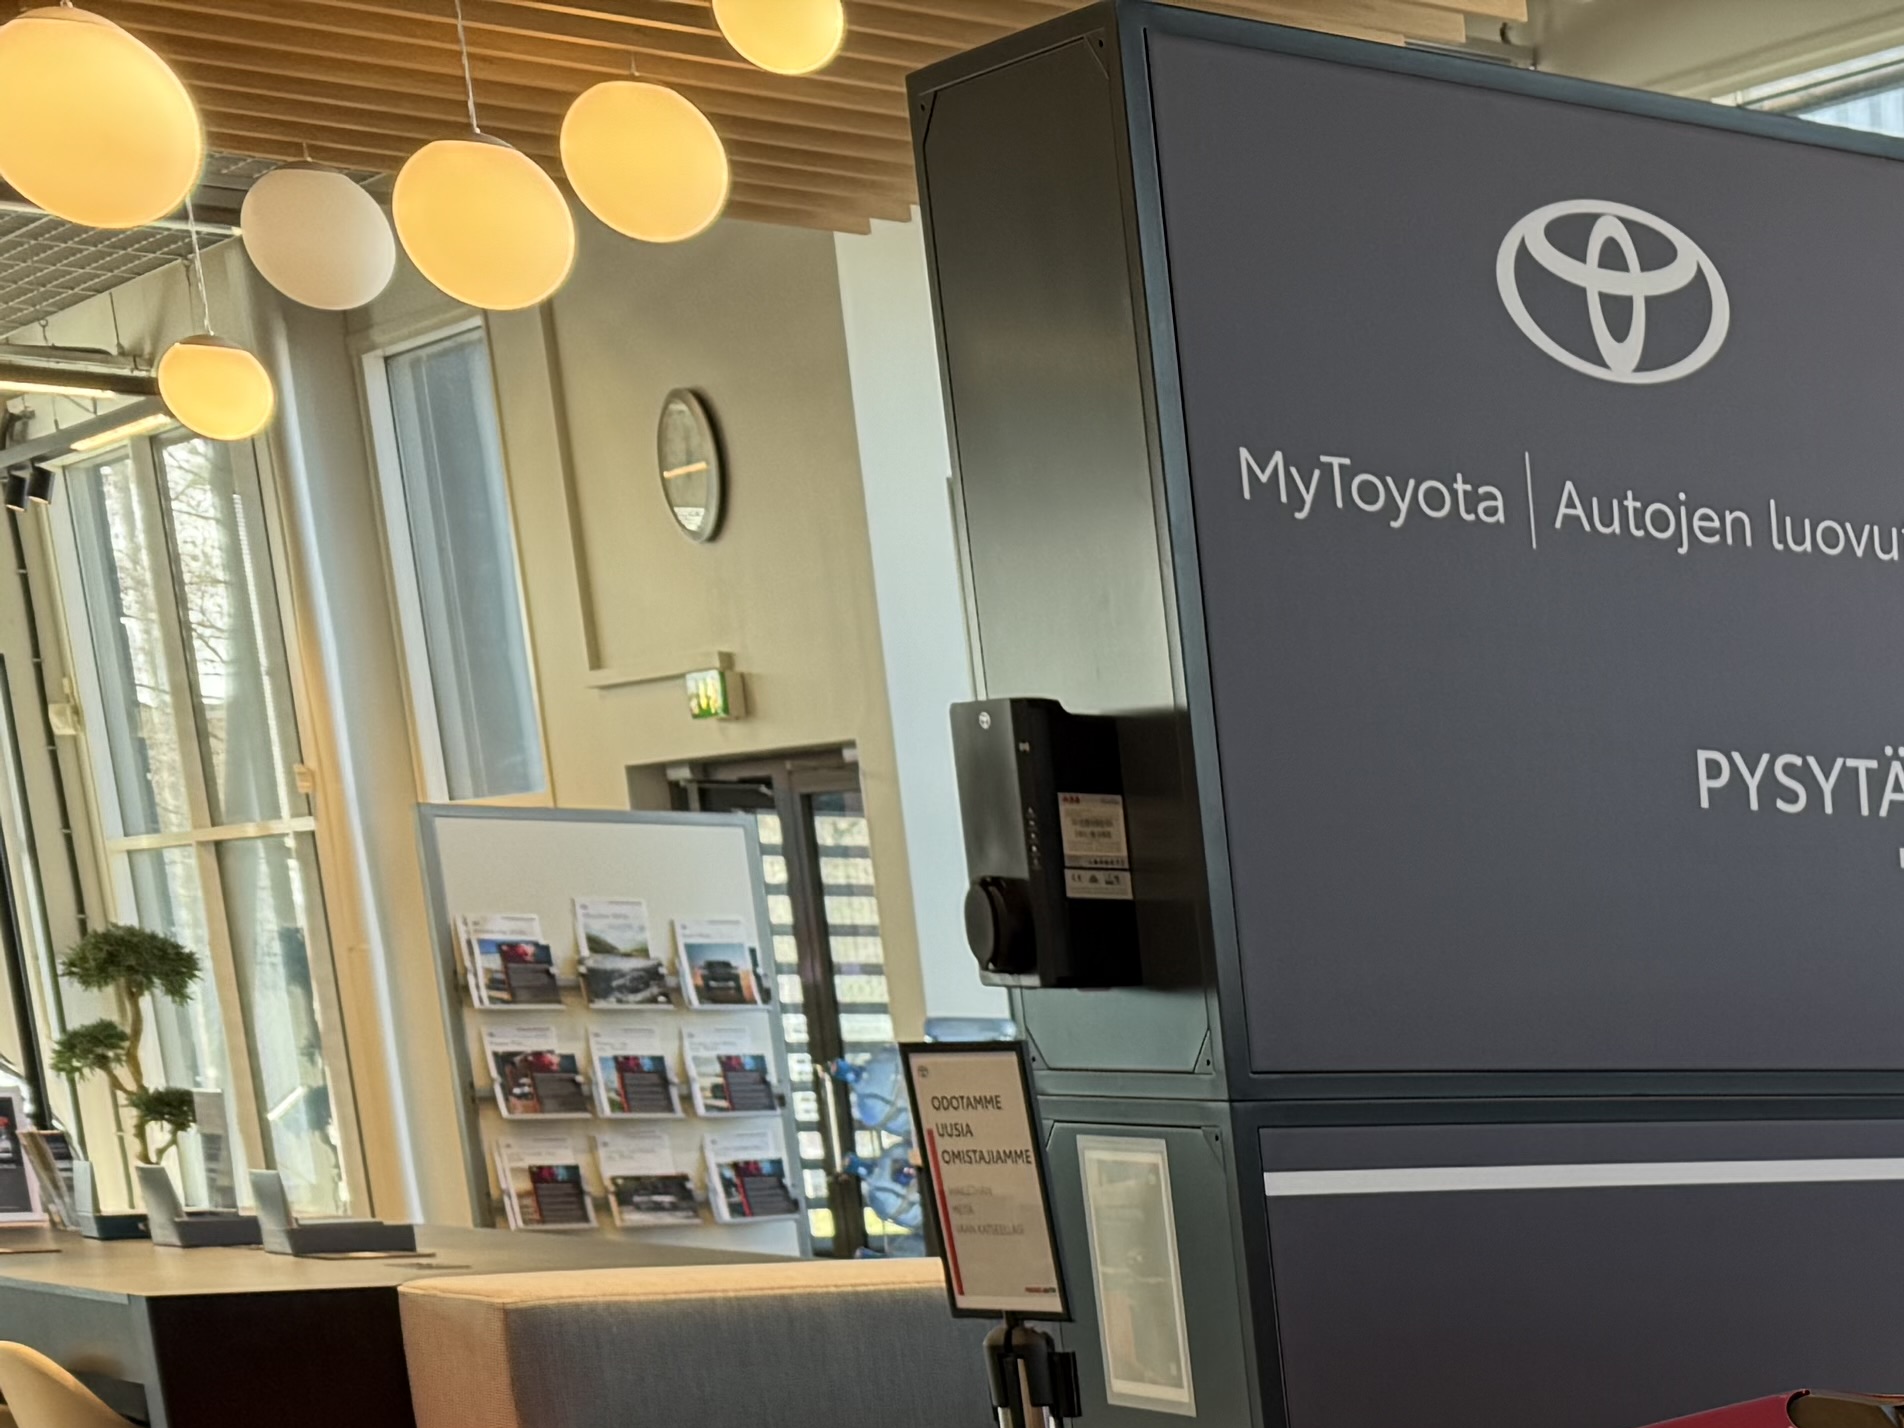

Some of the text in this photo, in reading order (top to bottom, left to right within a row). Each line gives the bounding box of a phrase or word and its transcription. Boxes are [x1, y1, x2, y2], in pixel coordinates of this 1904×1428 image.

[1238, 446, 1506, 528] MyToyota
[1554, 479, 1752, 554] Autojen
[931, 1095, 1003, 1111] ODOTAMME
[935, 1122, 974, 1138] UUSIA
[941, 1149, 1033, 1165] OMISTAJIAMME
